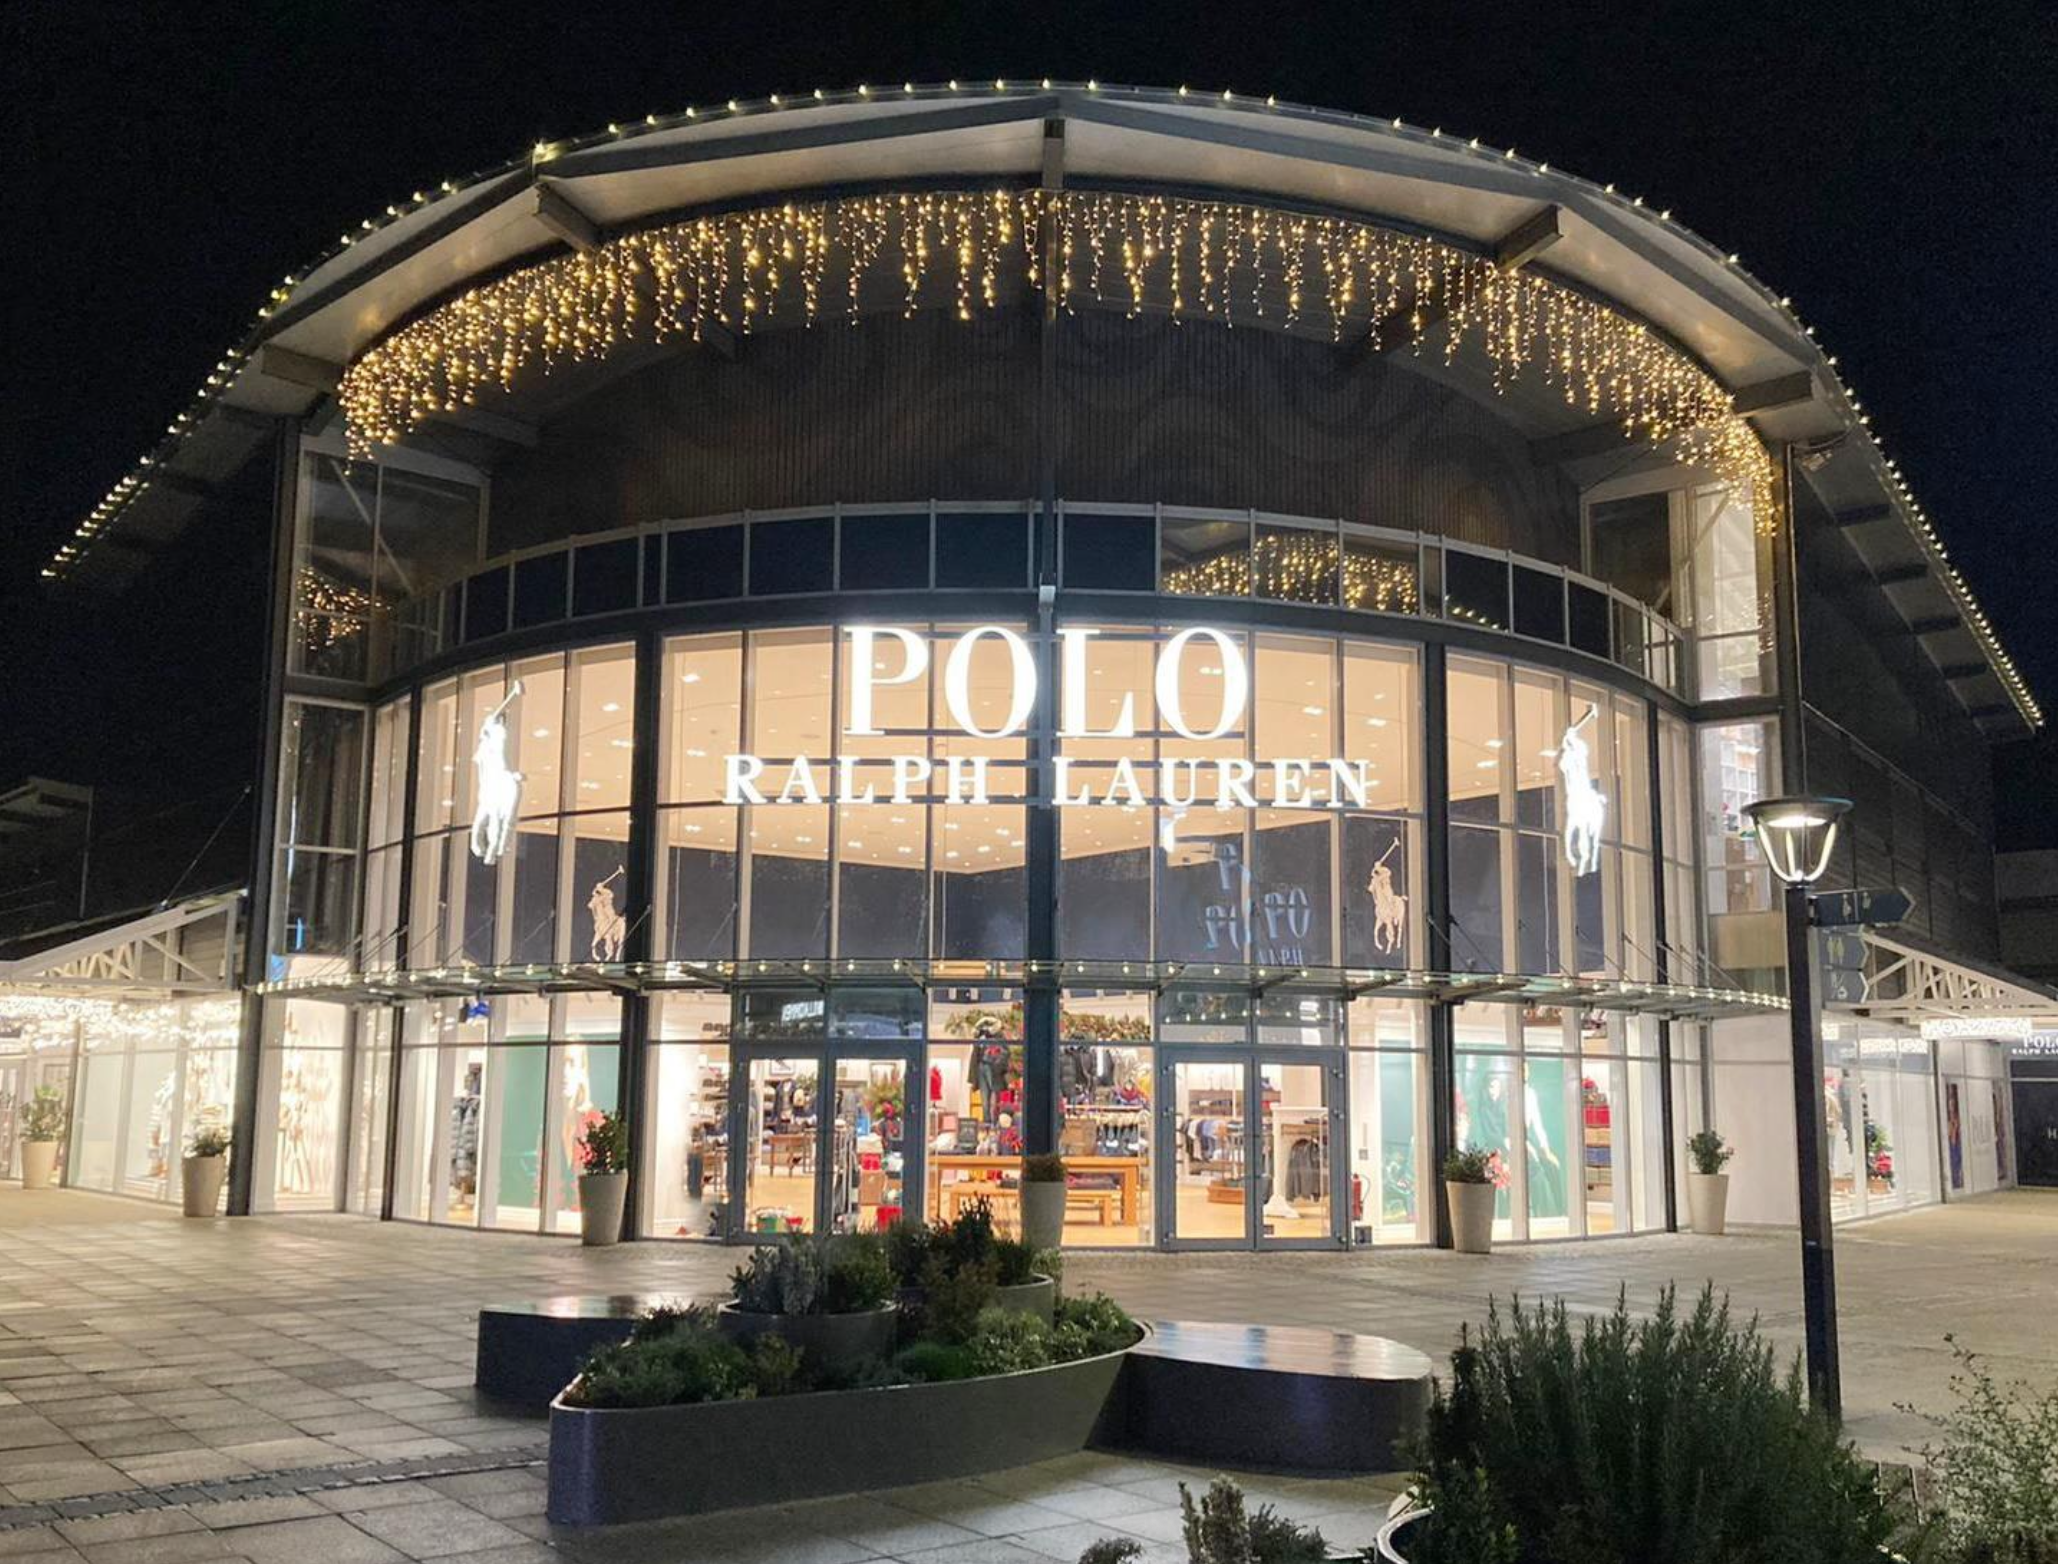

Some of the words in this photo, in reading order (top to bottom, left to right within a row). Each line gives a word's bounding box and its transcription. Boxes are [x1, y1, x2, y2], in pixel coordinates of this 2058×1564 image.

[844, 626, 1248, 740] POLO
[722, 754, 991, 804] RALPH
[1051, 756, 1371, 808] LAUREN
[2023, 1035, 2058, 1048] POL
